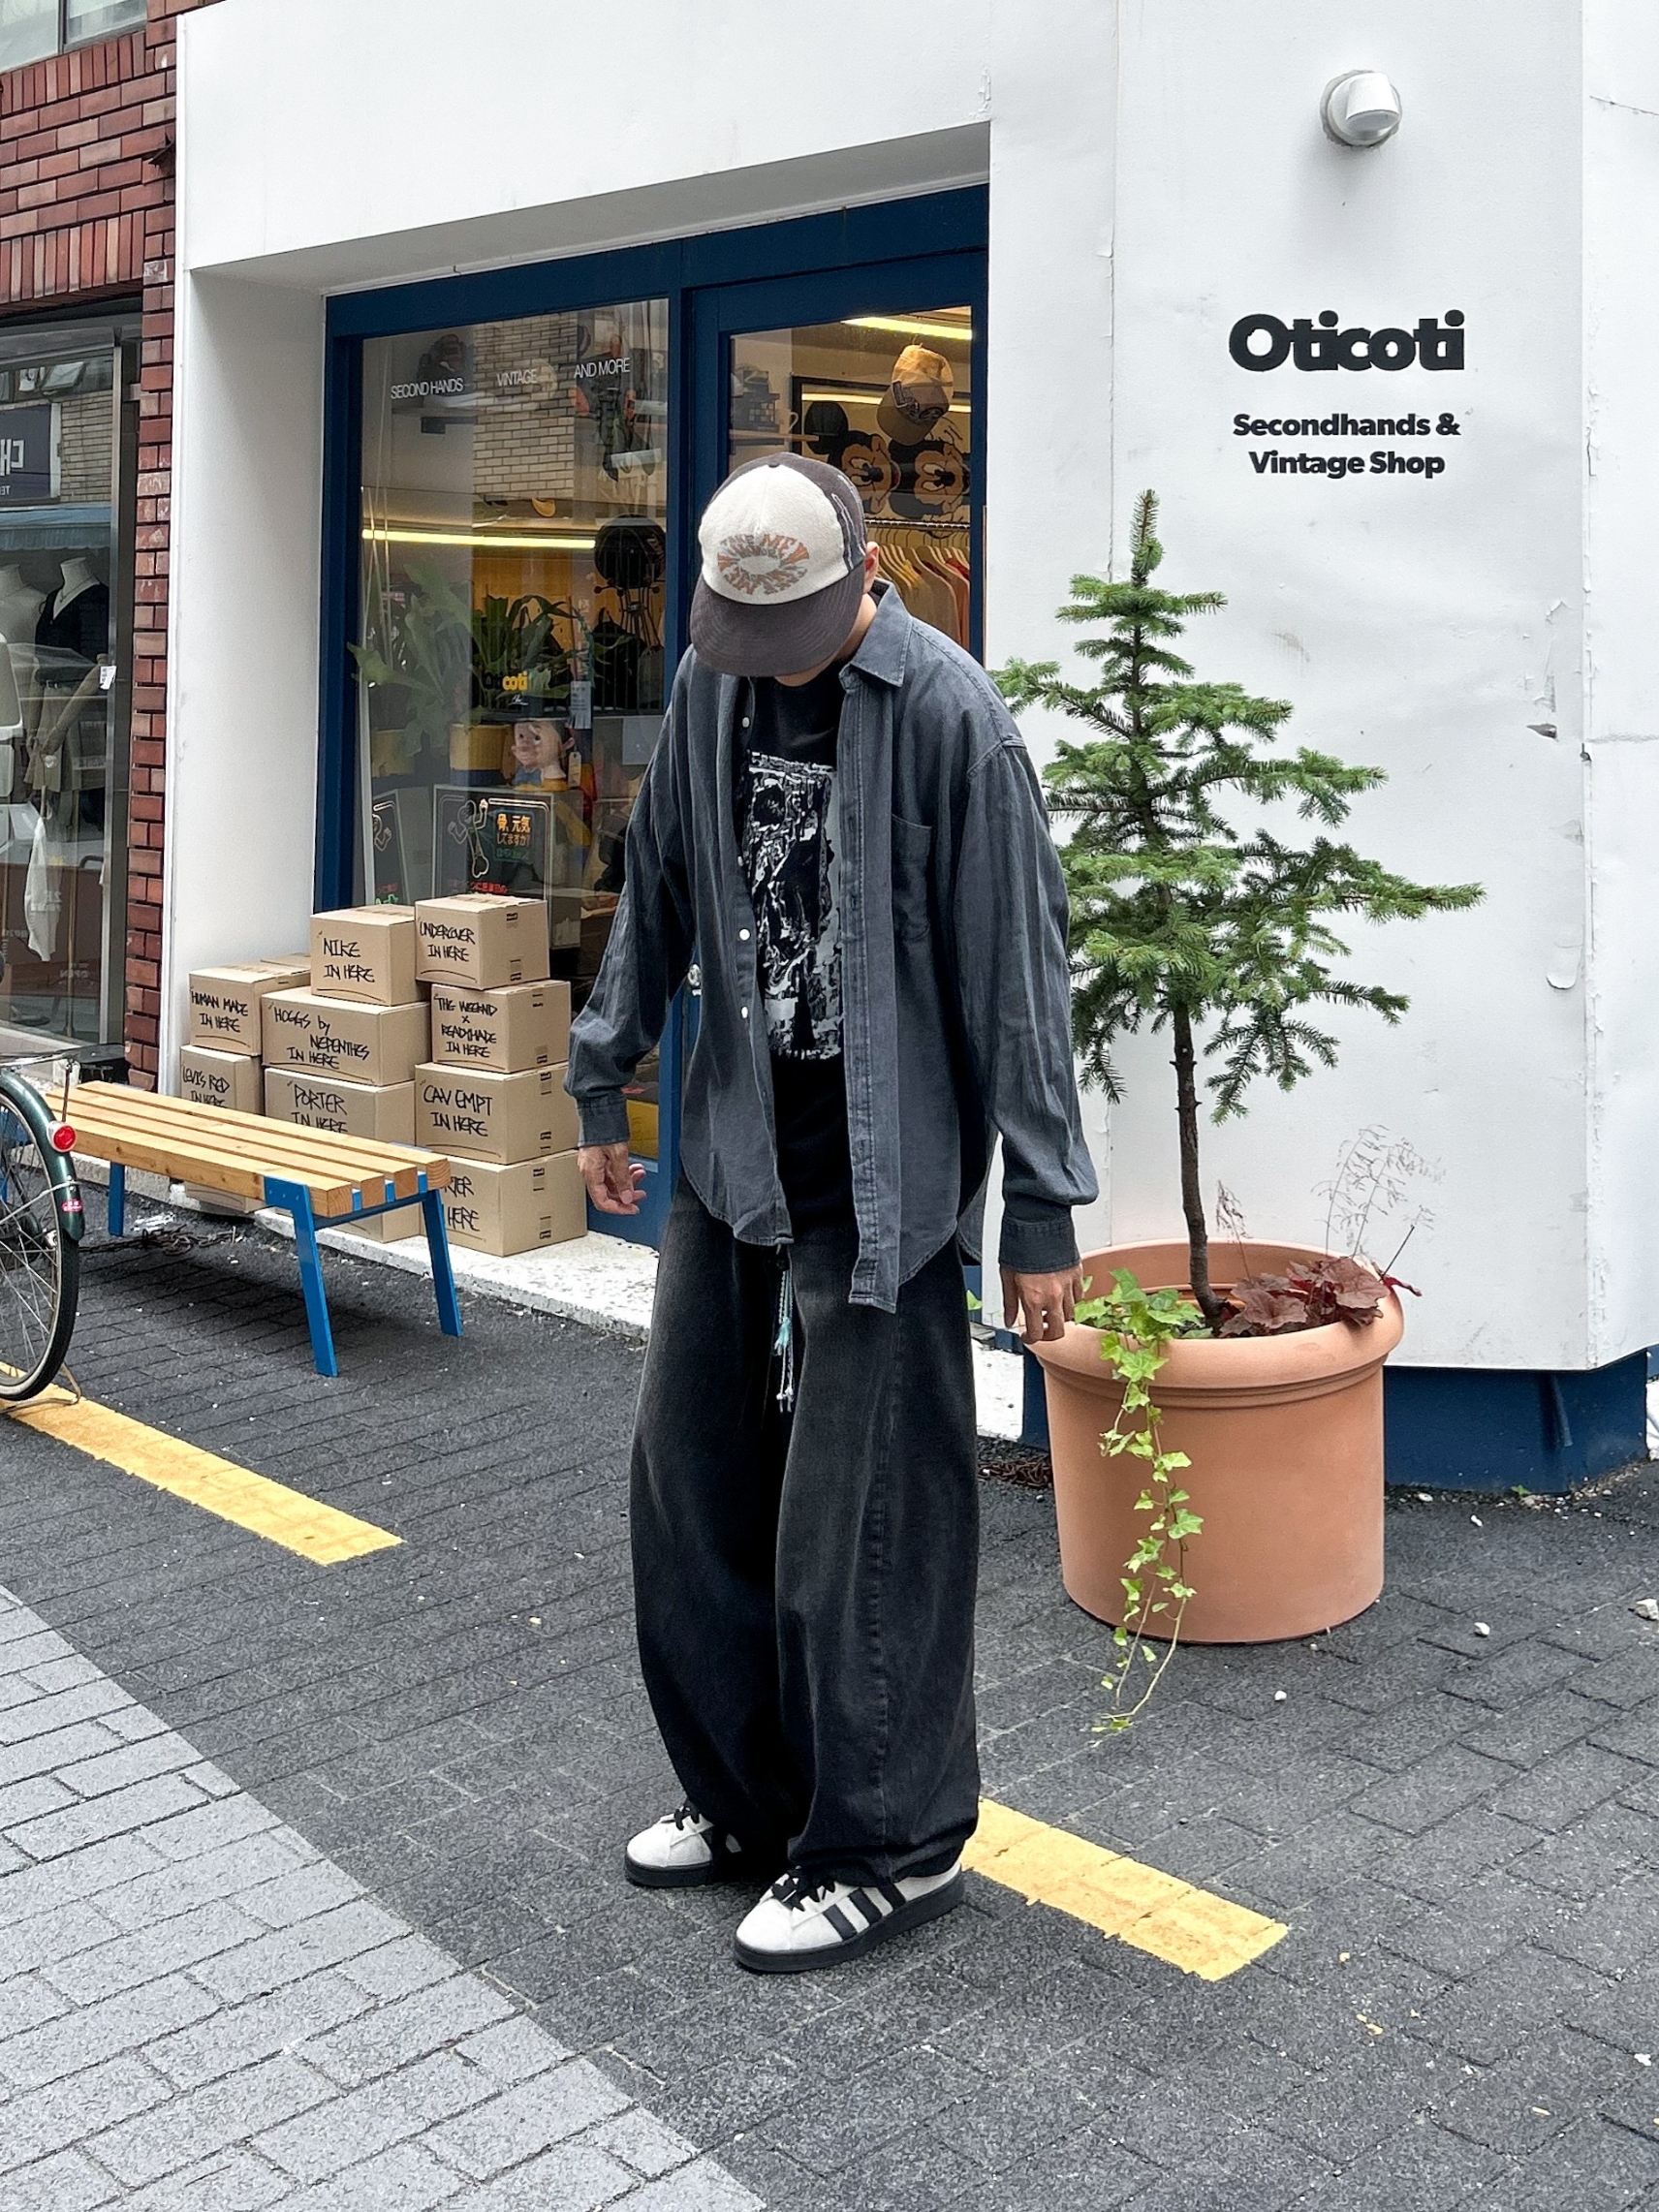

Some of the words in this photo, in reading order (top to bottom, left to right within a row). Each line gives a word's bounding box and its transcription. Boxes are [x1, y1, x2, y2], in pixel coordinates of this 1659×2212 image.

[1229, 309, 1465, 372] Oticoti
[497, 369, 538, 387] VINTAGE
[574, 363, 597, 379] AND
[599, 358, 631, 375] MORE
[391, 379, 429, 399] SECOND
[430, 378, 464, 394] HANDS
[1233, 413, 1431, 437] Secondhands
[1435, 413, 1462, 436] &
[1248, 450, 1365, 480] Vintage
[1369, 451, 1446, 480] Shop
[420, 921, 476, 945] UNDERCOVER
[324, 937, 361, 958] NIKE
[427, 944, 441, 958] IN
[443, 945, 469, 962] HERE
[324, 964, 341, 981] IN
[343, 964, 376, 983] HERE
[190, 990, 219, 1009] HUMAN
[223, 998, 249, 1016] MADE
[437, 997, 456, 1012] THE
[199, 1013, 212, 1029] IN
[214, 1014, 241, 1033] HERE
[273, 1007, 311, 1029] HOGGS
[317, 1014, 330, 1036] by
[441, 1023, 497, 1044] READYMADE
[286, 1046, 304, 1062] IN
[309, 1050, 340, 1070] HERE
[309, 1034, 370, 1061] NEPENTHES
[445, 1041, 461, 1054] IN
[462, 1044, 491, 1058] HERE
[294, 1083, 348, 1116] PORTER
[423, 1084, 453, 1106] CAV
[454, 1089, 493, 1116] EMPT
[430, 1111, 451, 1131] IN
[453, 1115, 489, 1137] HERE
[447, 1205, 481, 1232] HERE
